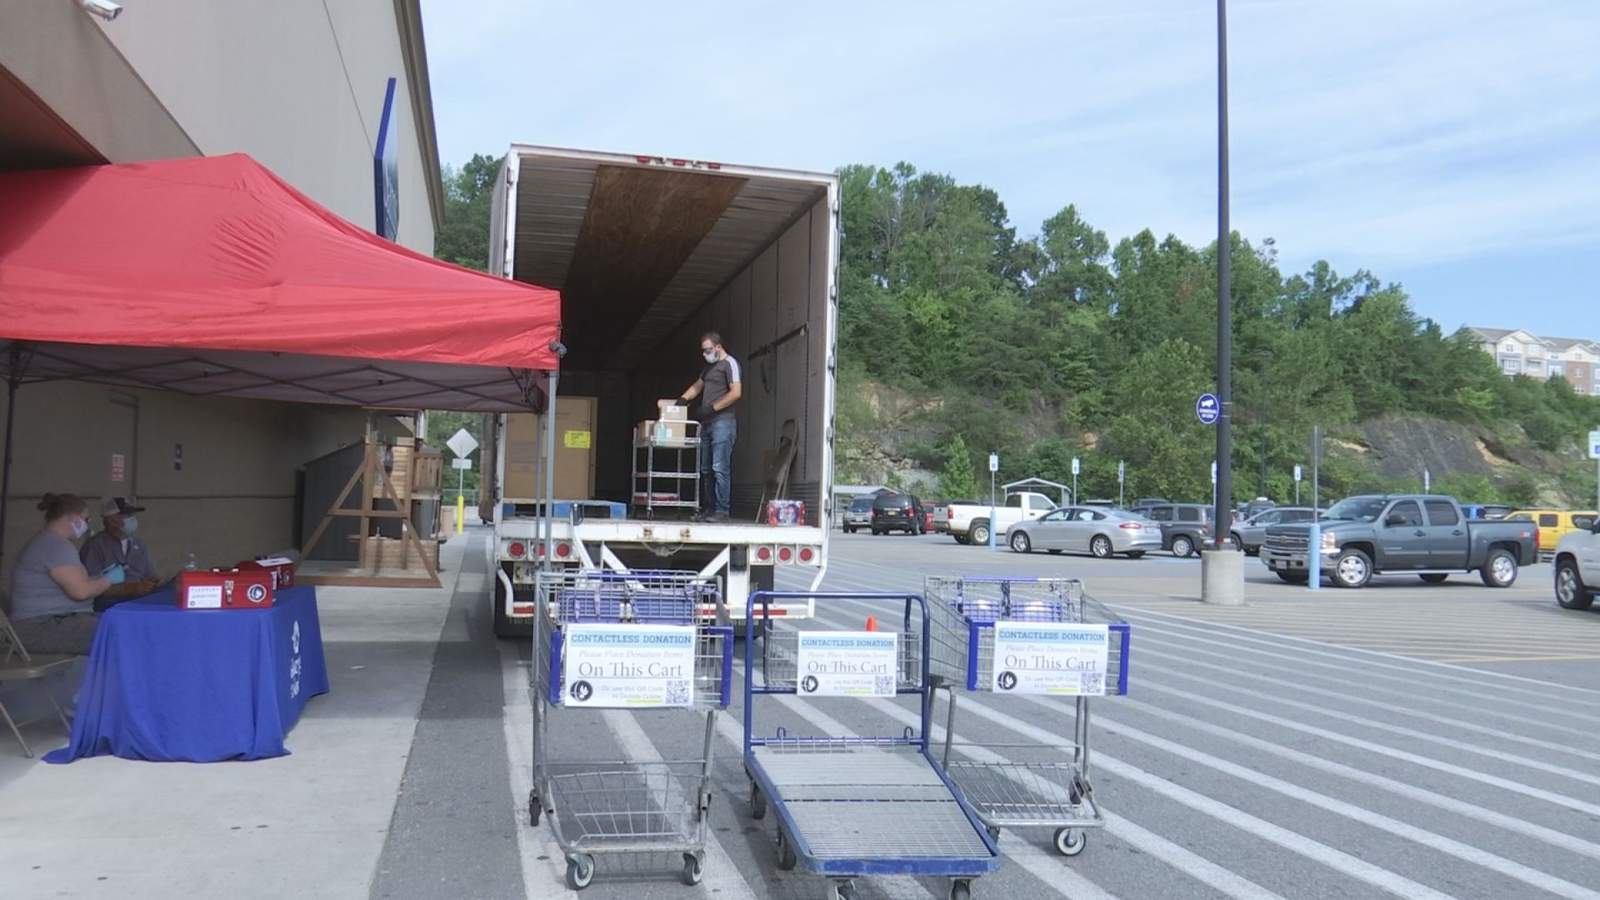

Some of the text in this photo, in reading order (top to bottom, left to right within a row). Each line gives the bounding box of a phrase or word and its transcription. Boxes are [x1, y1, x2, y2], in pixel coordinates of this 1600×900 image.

[571, 634, 691, 645] CONTACTLESS DONATION
[999, 631, 1105, 641] CONTACTLESS DONATION
[801, 639, 894, 648] CONTACTLESS DONATION
[578, 661, 682, 677] On This Cart
[807, 660, 887, 673] On This Cart
[1004, 655, 1096, 671] On This Cart
